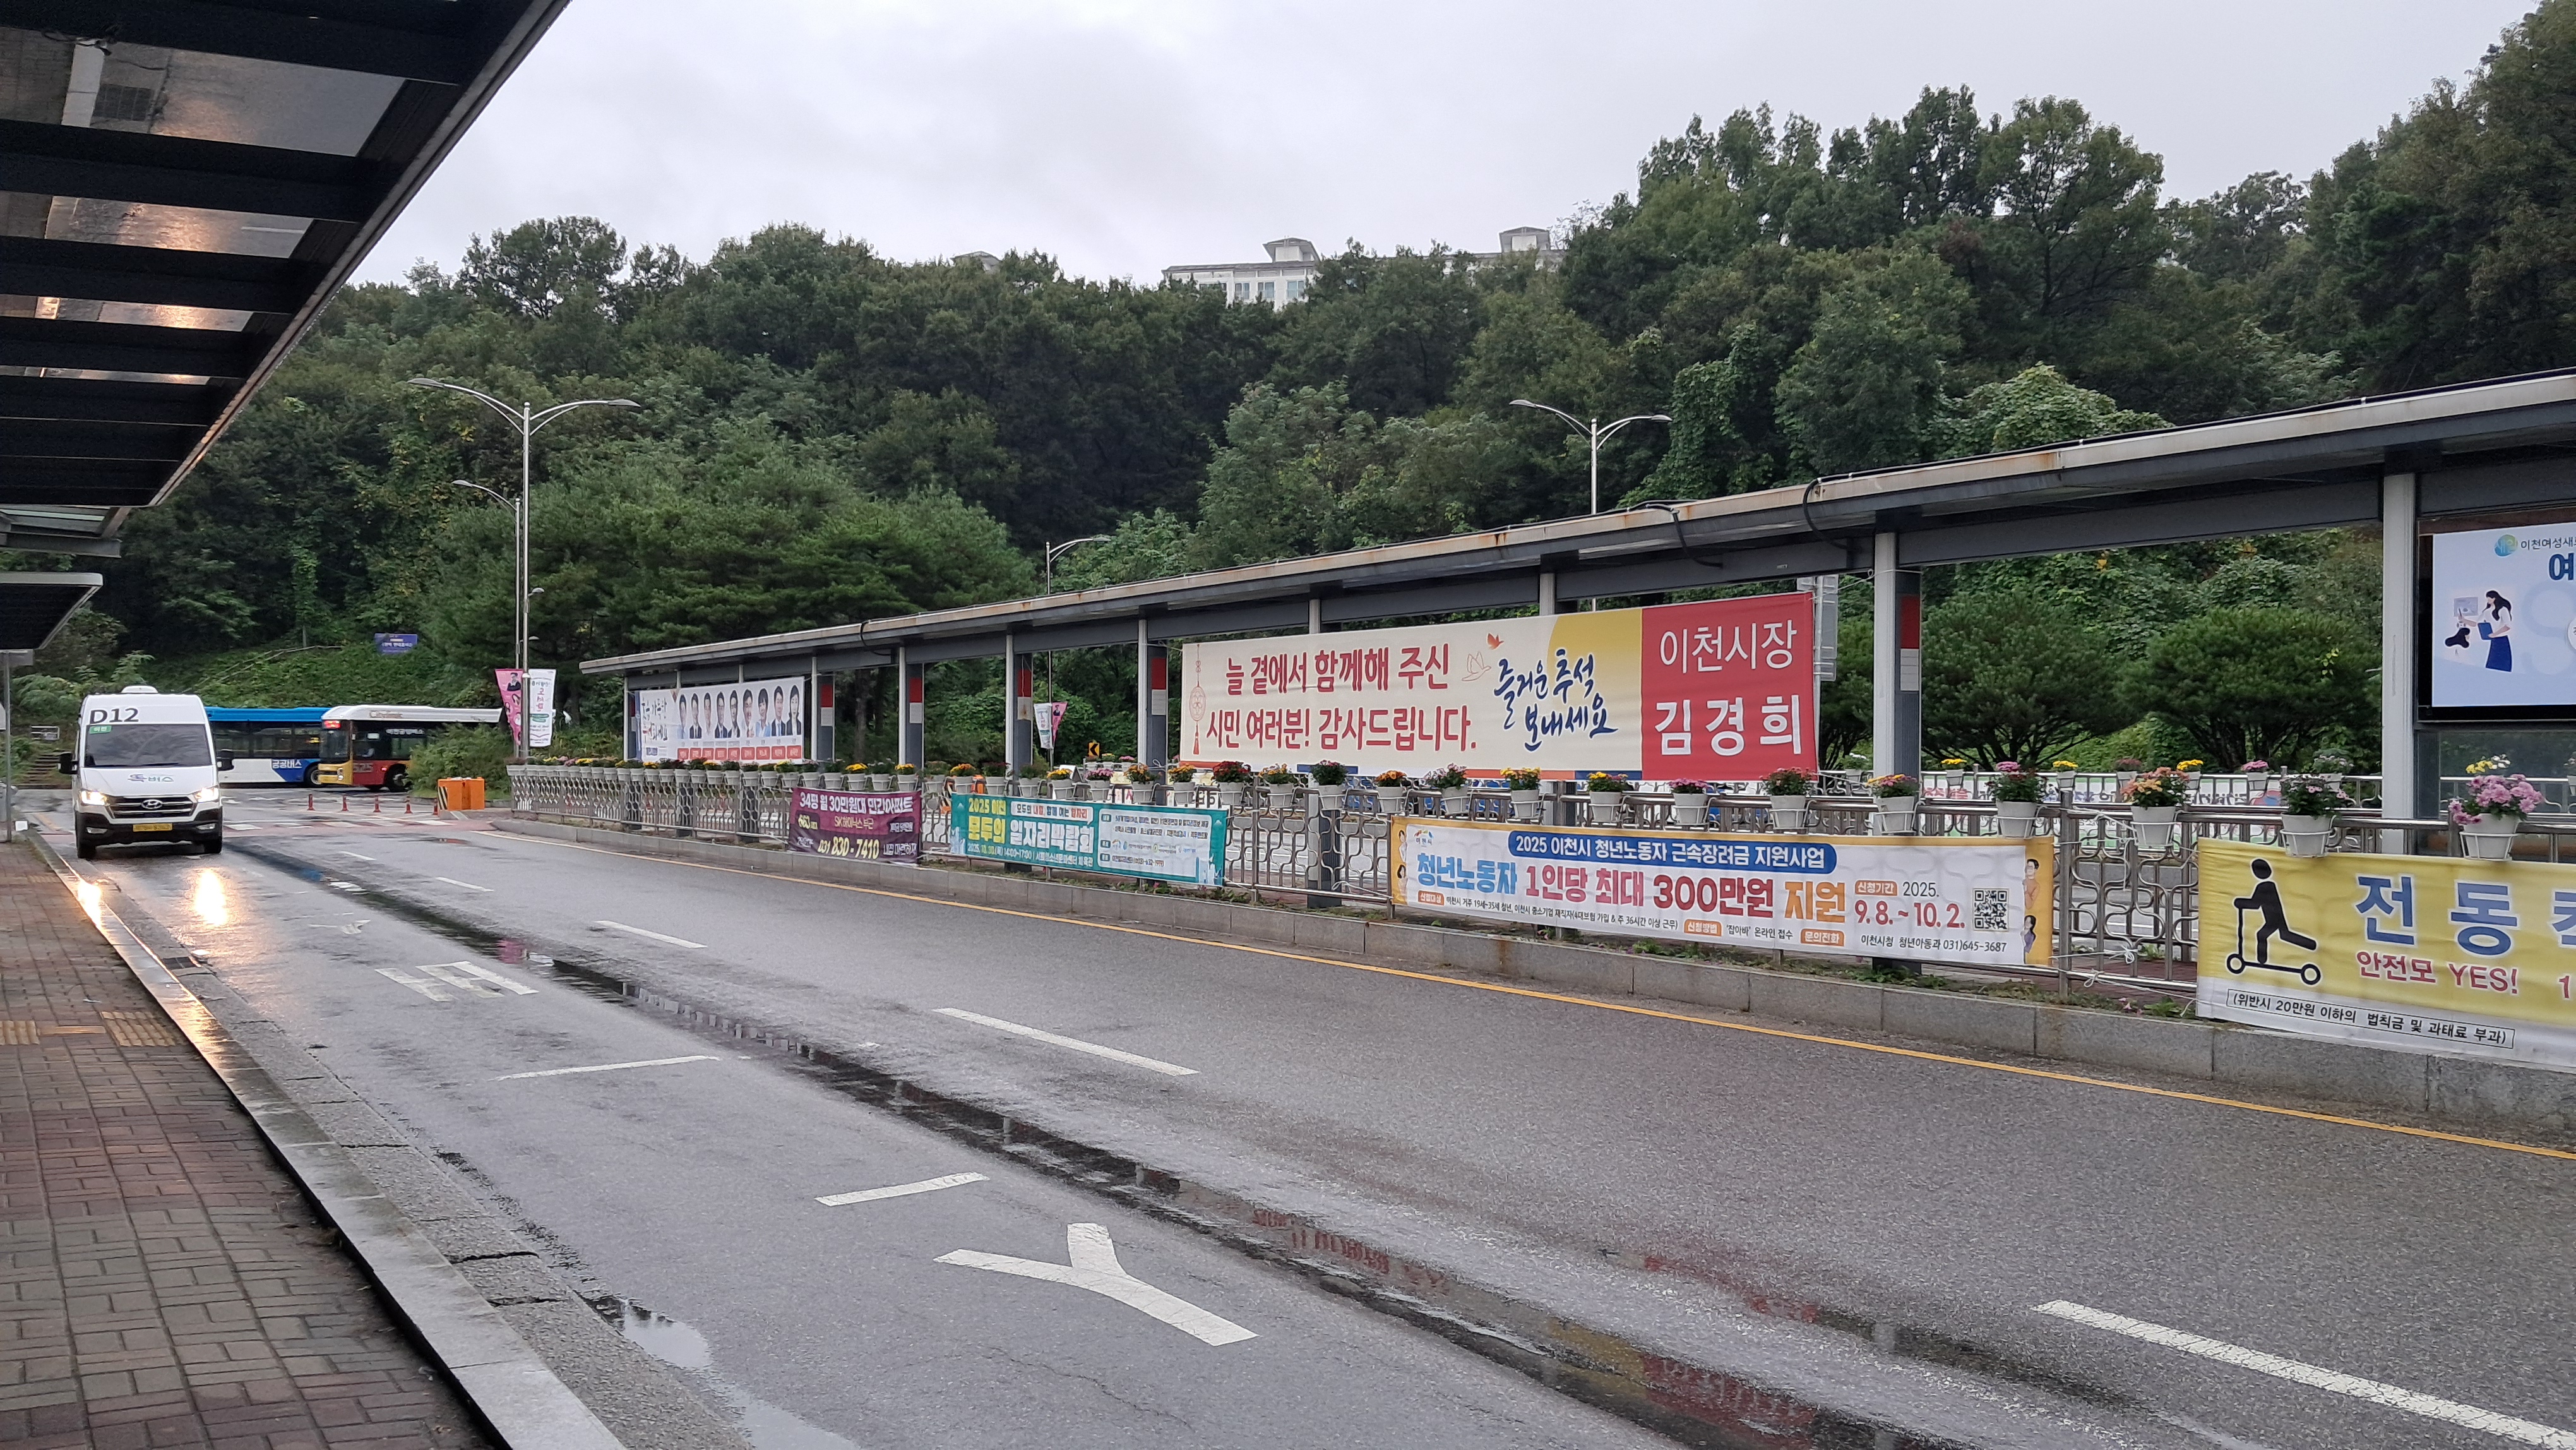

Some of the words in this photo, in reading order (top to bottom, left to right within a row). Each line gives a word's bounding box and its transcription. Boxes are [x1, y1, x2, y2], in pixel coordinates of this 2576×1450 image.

[2520, 536, 2576, 551] 이천여성새
[1226, 657, 1244, 695] 늘
[1251, 652, 1308, 695] 곁에서
[1315, 647, 1389, 693] 함께해
[1398, 643, 1449, 690] 주신
[1659, 620, 1798, 674] 이천시장
[1493, 659, 1549, 731] 즐거운
[1553, 648, 1594, 704] 추석
[90, 707, 140, 724] D12
[1206, 709, 1240, 748] 시민
[1246, 707, 1310, 749] 여러분!
[1318, 705, 1477, 752] 감사드립니다.
[1524, 693, 1619, 752] 보내세요
[1654, 695, 1802, 757] 김경희
[799, 792, 819, 810] 34평
[829, 795, 866, 814] 30만원대
[968, 798, 990, 813] 2025
[968, 815, 1006, 844] 모두의
[1010, 820, 1095, 854] 일자리박람회
[1516, 836, 1547, 853] 2025
[1551, 837, 1591, 857] 이천시
[1594, 840, 1667, 861] 청년노동자
[1671, 842, 1750, 866] 근속장려금
[1755, 846, 1825, 869] 지원사업
[1417, 853, 1518, 894] 청년노동자
[1525, 865, 1588, 902] 1인당
[1595, 868, 1644, 908] 최대
[1653, 874, 1774, 918] 300만원
[1785, 881, 1846, 923] 지원
[1857, 882, 1895, 895] 신청기간
[1902, 881, 1940, 898] 2025.
[1446, 897, 1462, 907] 이천시
[1462, 897, 1473, 908] 거주
[1474, 899, 1500, 912] 19세~35세
[1501, 902, 1513, 914] 청년,
[1514, 904, 1531, 914] 이천시
[1532, 906, 1554, 917] 중소기업
[1597, 912, 1609, 923] 가입
[1617, 915, 1625, 925] 주
[1625, 916, 1647, 928] 36시간
[1647, 918, 1661, 929] 이상
[1662, 919, 1678, 930] 근무)
[1754, 926, 1776, 940] 온라인
[1777, 928, 1794, 941] 접수
[1861, 934, 1894, 947] 이천시청
[1898, 937, 1941, 950] 청년아동과
[1943, 938, 2007, 952] 031)645-3687
[2356, 950, 2436, 984] 안전모
[2448, 963, 2519, 995] YES!
[2232, 992, 2272, 1011] (위반시
[2275, 999, 2316, 1017] 20만원
[2320, 1005, 2357, 1024] 이하의
[2409, 1018, 2423, 1033] 및
[2428, 1021, 2468, 1040] 과태료
[2474, 1028, 2507, 1045] 부과)
